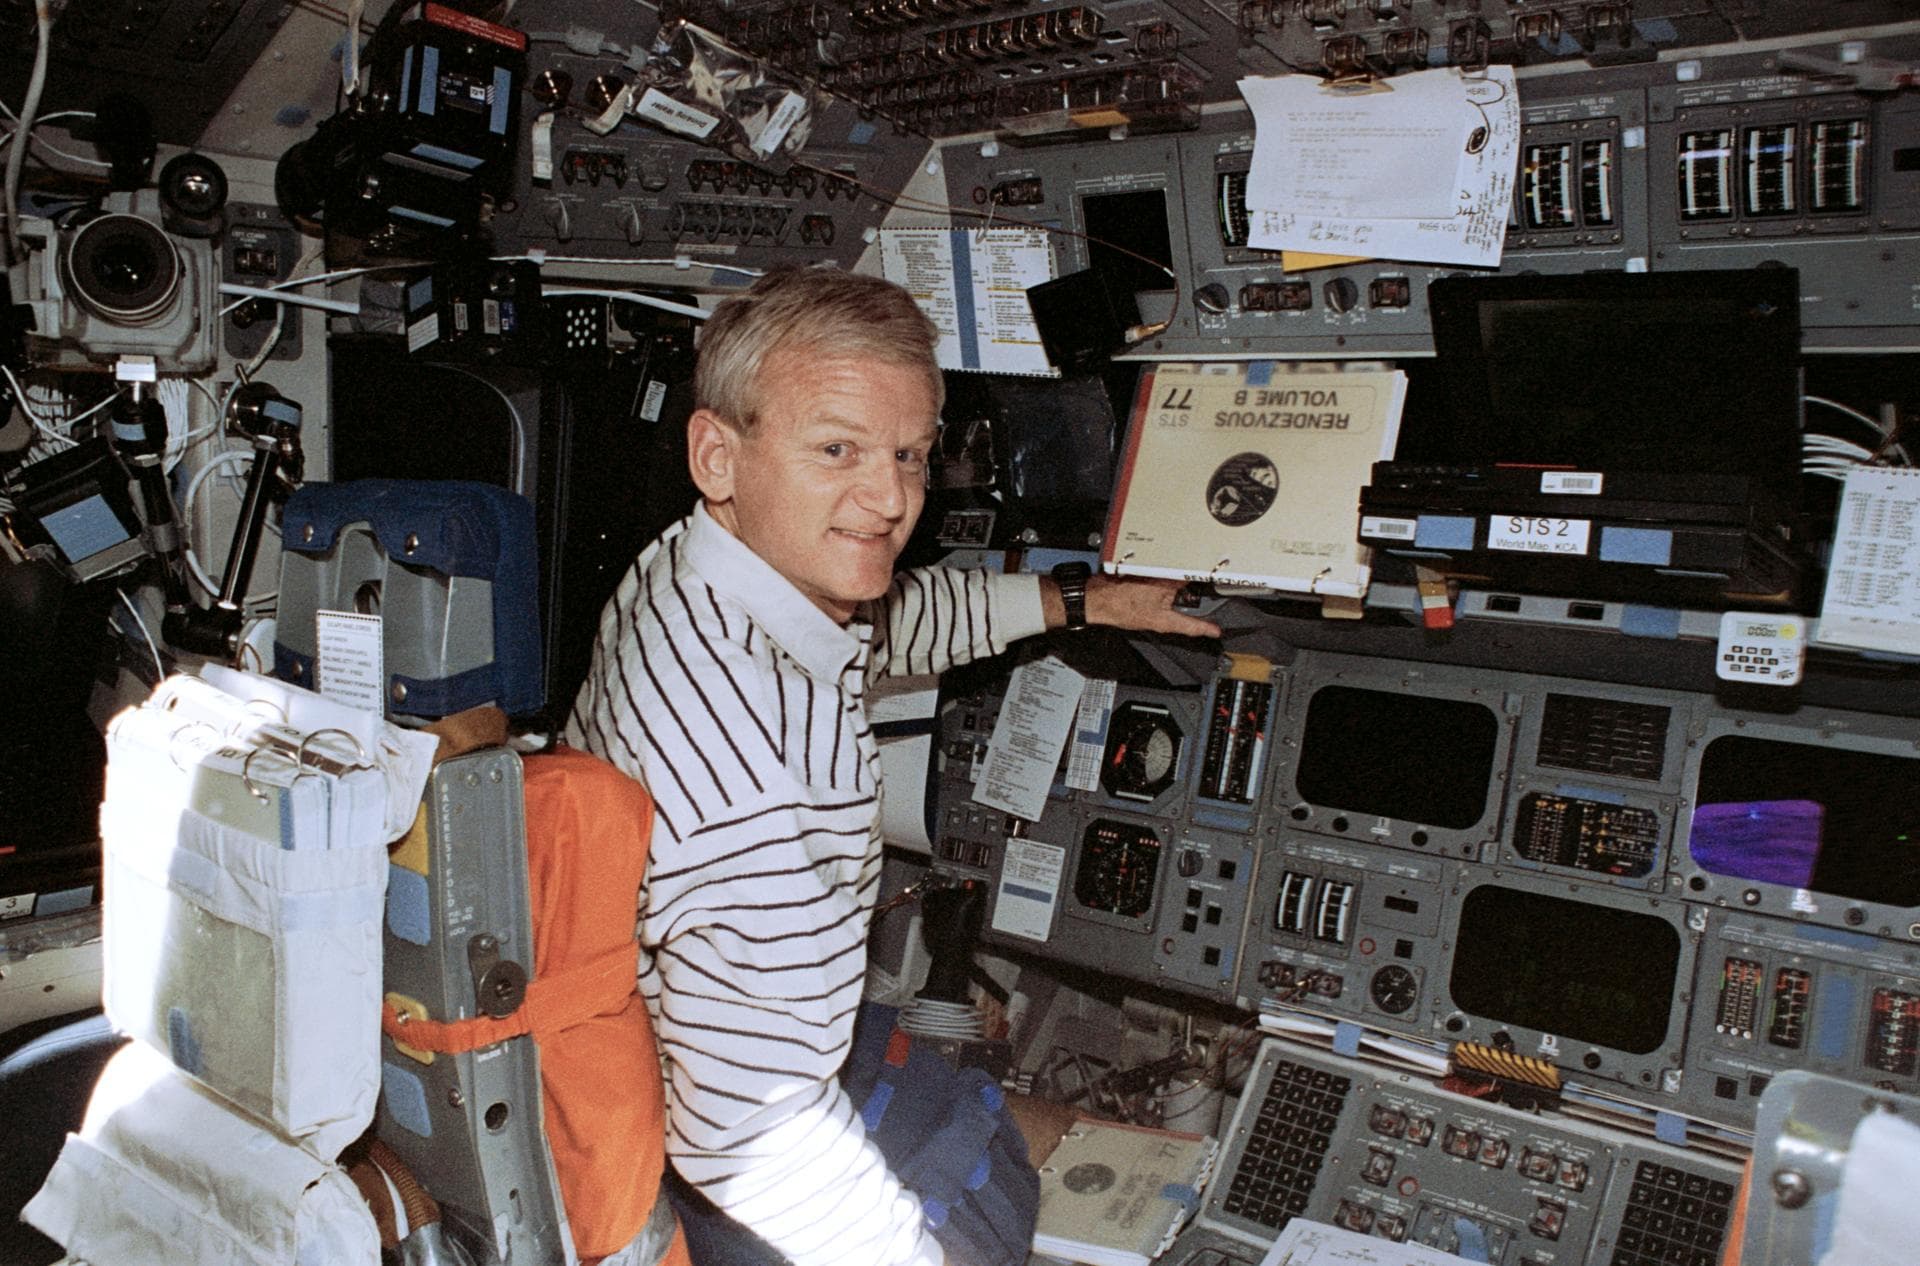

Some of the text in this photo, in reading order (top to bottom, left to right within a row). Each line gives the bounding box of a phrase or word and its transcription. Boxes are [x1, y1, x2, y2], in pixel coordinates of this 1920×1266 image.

[1161, 388, 1193, 410] 77
[1234, 389, 1338, 406] VOLUME B
[1158, 413, 1189, 427] STS
[1214, 411, 1350, 430] RENDEZVOUS
[1508, 516, 1570, 537] STS 2
[1496, 538, 1525, 549] World
[445, 868, 455, 908] FOLD
